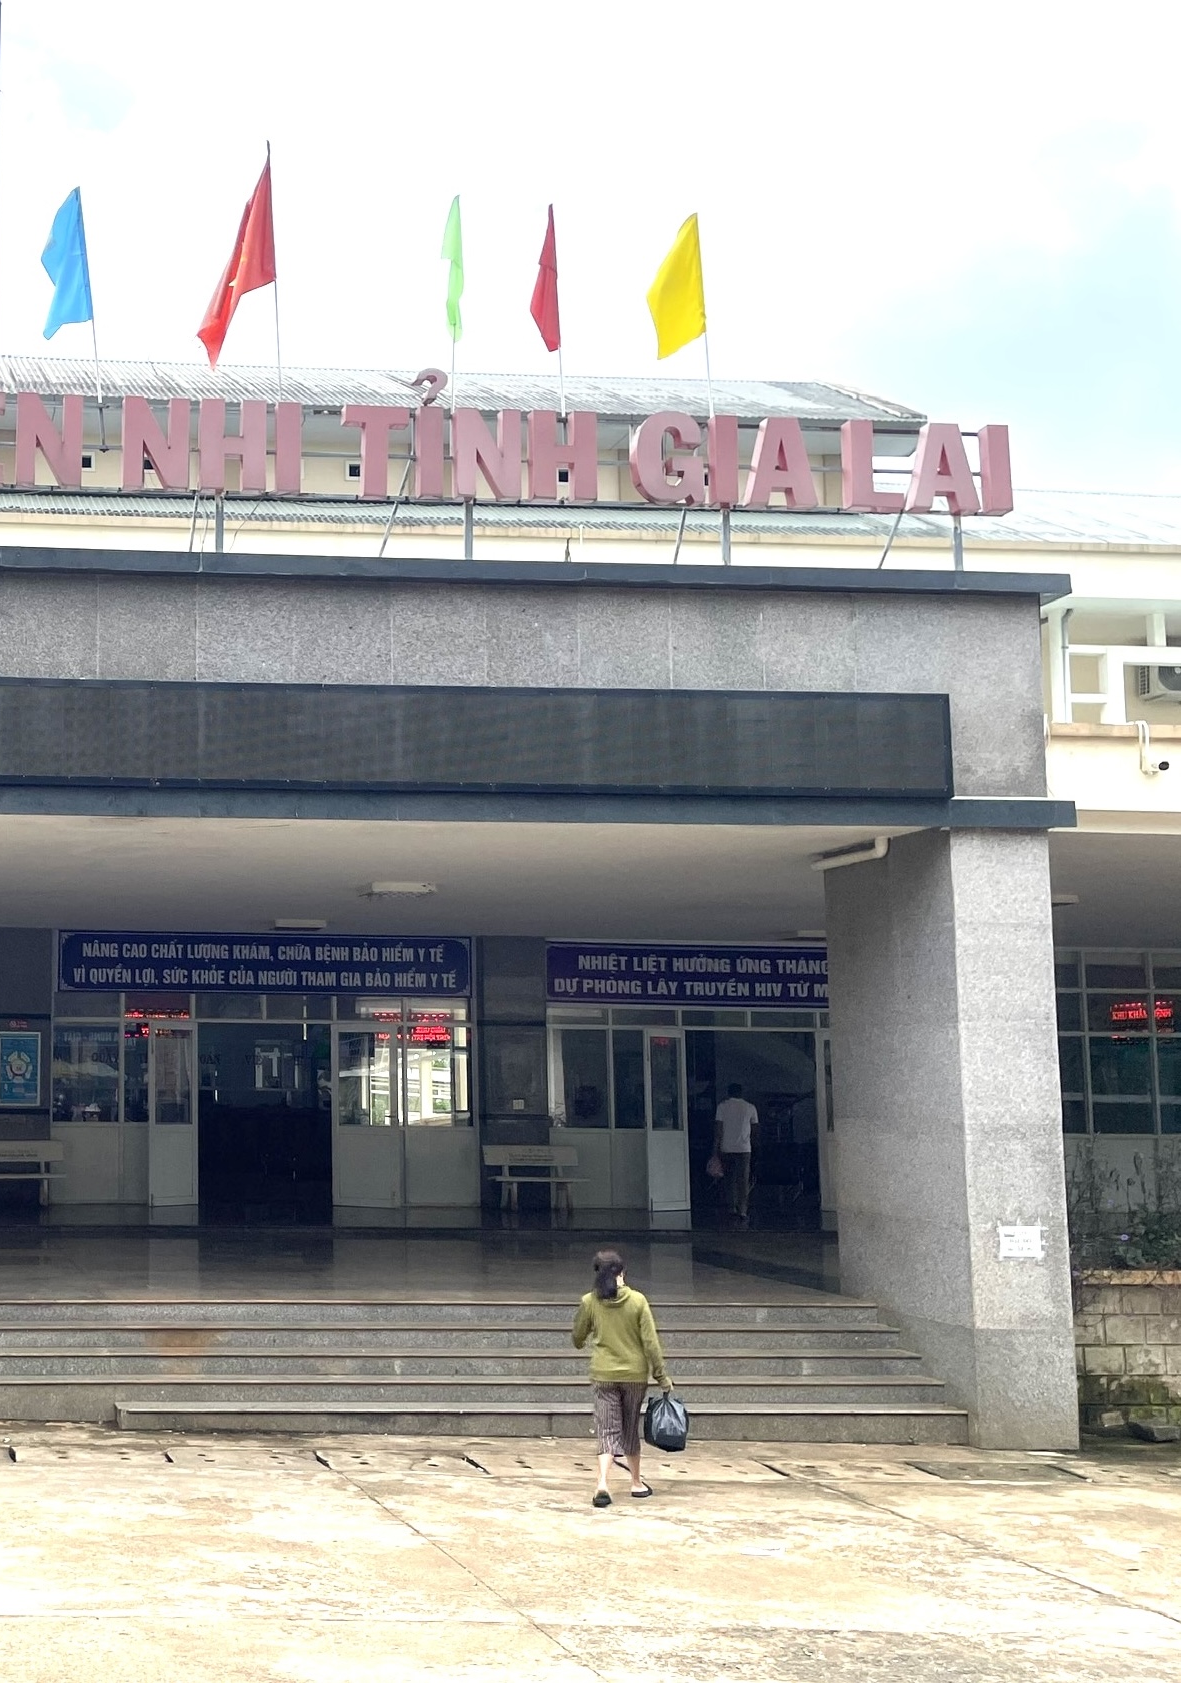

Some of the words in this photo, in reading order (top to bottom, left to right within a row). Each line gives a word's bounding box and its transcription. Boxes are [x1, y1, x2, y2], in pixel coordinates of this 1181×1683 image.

[122, 396, 301, 494] NHI
[341, 368, 597, 504] TỈNH
[630, 410, 818, 511] GIA
[841, 419, 1014, 516] LAI
[82, 940, 118, 958] NÂNG
[122, 943, 147, 958] CAO
[151, 939, 184, 959] CHẤT
[187, 943, 229, 962] LƯỢNG
[233, 942, 274, 961] KHÁM,
[278, 943, 311, 961] CHỮA
[315, 944, 349, 964] BỆNH
[352, 942, 378, 962] BẢO
[381, 942, 414, 962] HIỂM
[417, 947, 426, 962] Y
[429, 944, 444, 963] TẾ
[578, 953, 628, 974] NHIỆT
[633, 954, 667, 975] LIỆT
[672, 953, 731, 973] HƯỞNG
[736, 955, 771, 974] ỨNG
[73, 964, 86, 983] VÌ
[89, 963, 132, 984] QUYỀN
[135, 967, 159, 986] LỢI,
[163, 966, 188, 984] SỨC
[191, 964, 225, 985] KHỎE
[229, 964, 255, 985] CỦA
[258, 967, 297, 986] NGƯỜI
[301, 971, 337, 987] THAM
[340, 971, 361, 987] GIA
[365, 967, 391, 987] BẢO
[394, 966, 426, 988] HIỂM
[430, 973, 438, 988] Y
[442, 969, 457, 988] TẾ
[554, 977, 579, 996] DỰ
[583, 976, 642, 994] PHÒNG
[647, 978, 678, 995] LÂY
[755, 982, 783, 997] HIV
[787, 980, 810, 997] TỪ
